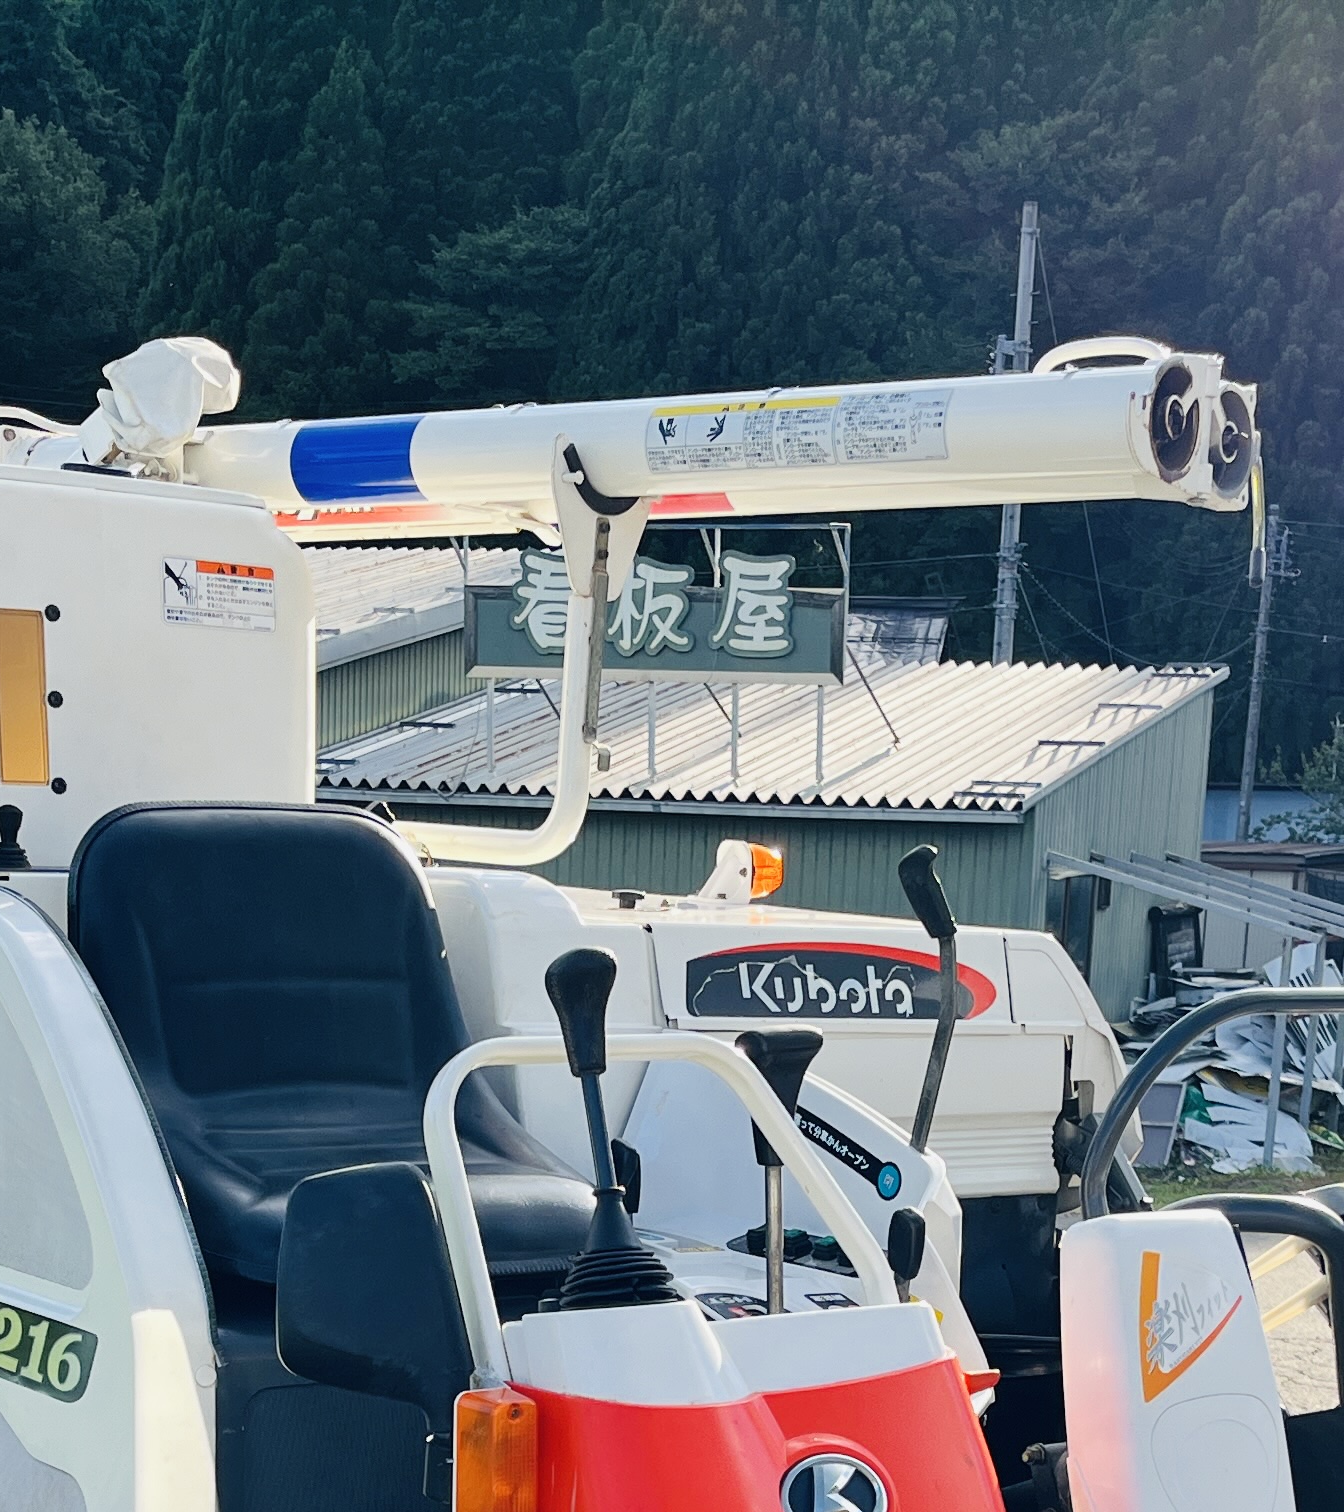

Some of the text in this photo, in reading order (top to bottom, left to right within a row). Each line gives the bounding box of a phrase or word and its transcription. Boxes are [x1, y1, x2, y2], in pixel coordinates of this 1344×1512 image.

[514, 554, 791, 651] 看板屋
[738, 961, 914, 1017] Kubota
